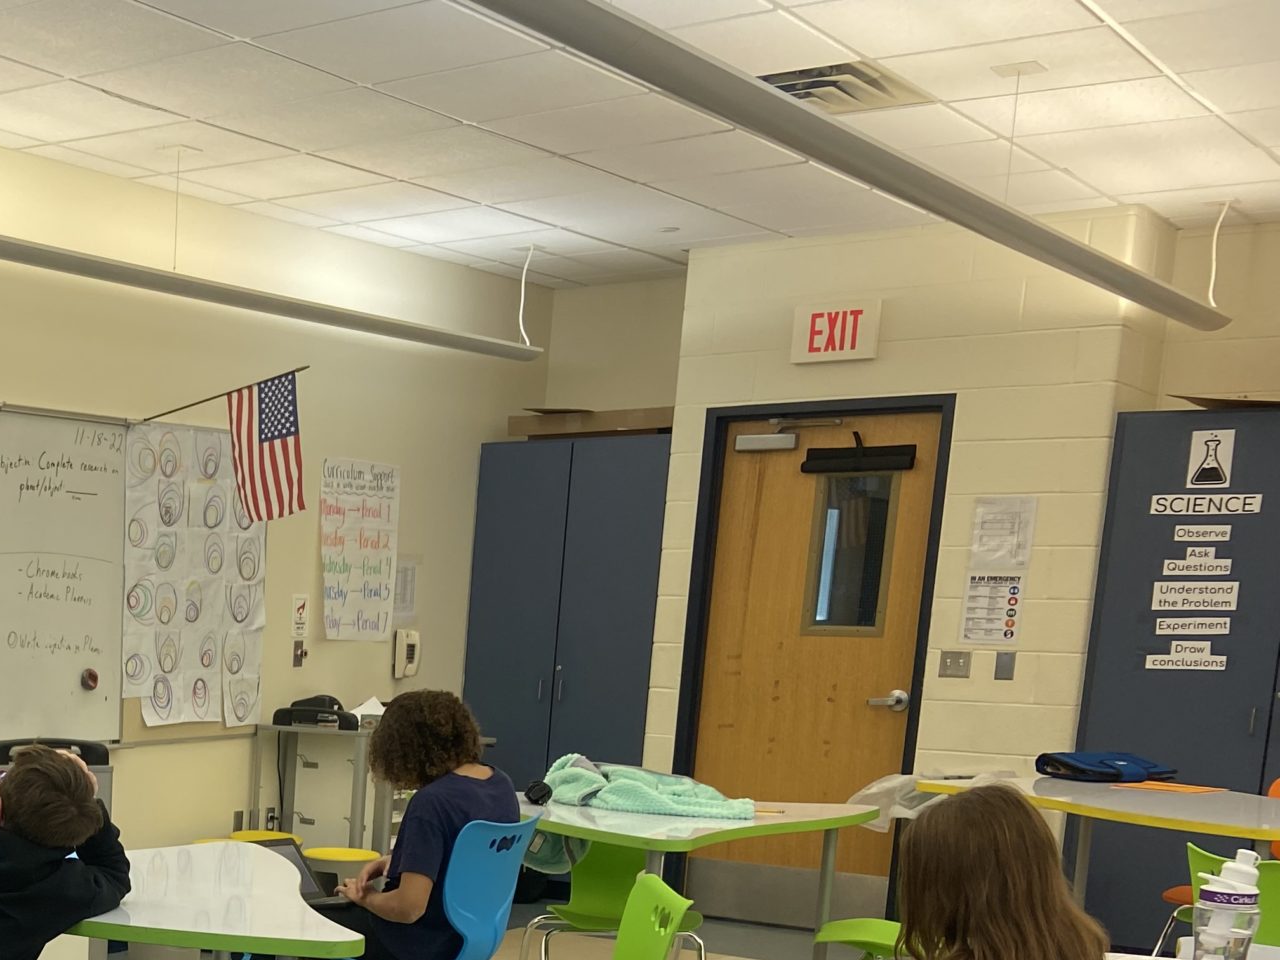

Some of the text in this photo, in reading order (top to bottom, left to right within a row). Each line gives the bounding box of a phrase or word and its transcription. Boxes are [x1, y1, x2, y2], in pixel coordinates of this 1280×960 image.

[808, 309, 864, 353] EXIT
[38, 451, 74, 477] Complete
[323, 458, 365, 480] Curriculum
[370, 464, 395, 490] Support
[1154, 496, 1258, 513] SCIENCE
[1176, 528, 1228, 539] Observe
[382, 533, 392, 551] 2
[1189, 549, 1210, 559] Ask
[1167, 562, 1229, 573] Questions
[383, 583, 391, 600] 5
[1160, 585, 1234, 595] Understand
[1159, 598, 1232, 608] the Problem
[1158, 621, 1228, 632] Experiment
[1175, 644, 1205, 654] Draw
[1152, 658, 1225, 668] conclusions
